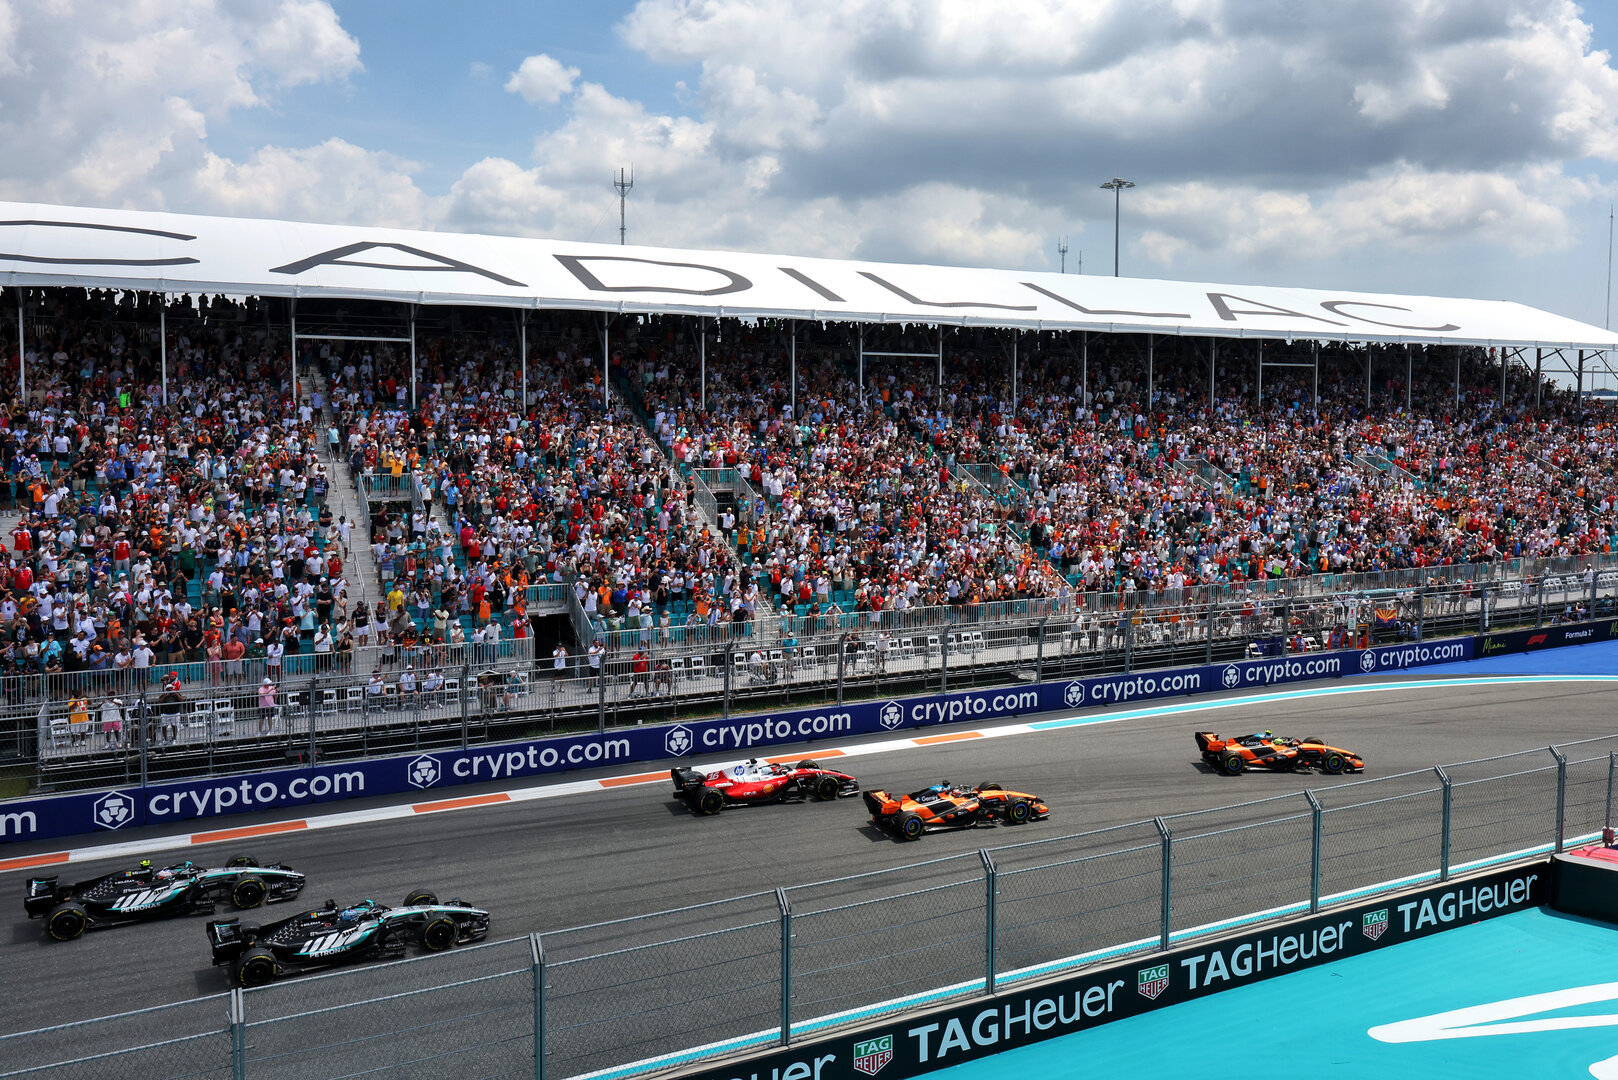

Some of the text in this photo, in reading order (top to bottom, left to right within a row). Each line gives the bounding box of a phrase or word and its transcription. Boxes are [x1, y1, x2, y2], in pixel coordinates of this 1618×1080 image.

[1565, 630, 1588, 639] Formula
[1380, 643, 1464, 667] crypto.com
[1482, 637, 1507, 654] Miami
[1245, 658, 1341, 682] crypto.com
[1091, 673, 1200, 700] crypto.com
[911, 691, 1038, 722] crypto.com
[702, 713, 851, 747] crypto.com
[453, 739, 630, 778] crypto.com
[707, 772, 720, 781] 16
[149, 770, 365, 816] crypto.com
[120, 903, 161, 914] PETRONAS
[1365, 912, 1387, 923] TAG
[1363, 921, 1388, 940] HEUER
[309, 945, 351, 958] PETRONAS
[1140, 966, 1167, 980] TAG
[1139, 978, 1168, 999] HEUER
[857, 1036, 890, 1056] TAG
[855, 1051, 892, 1074] HEUER
